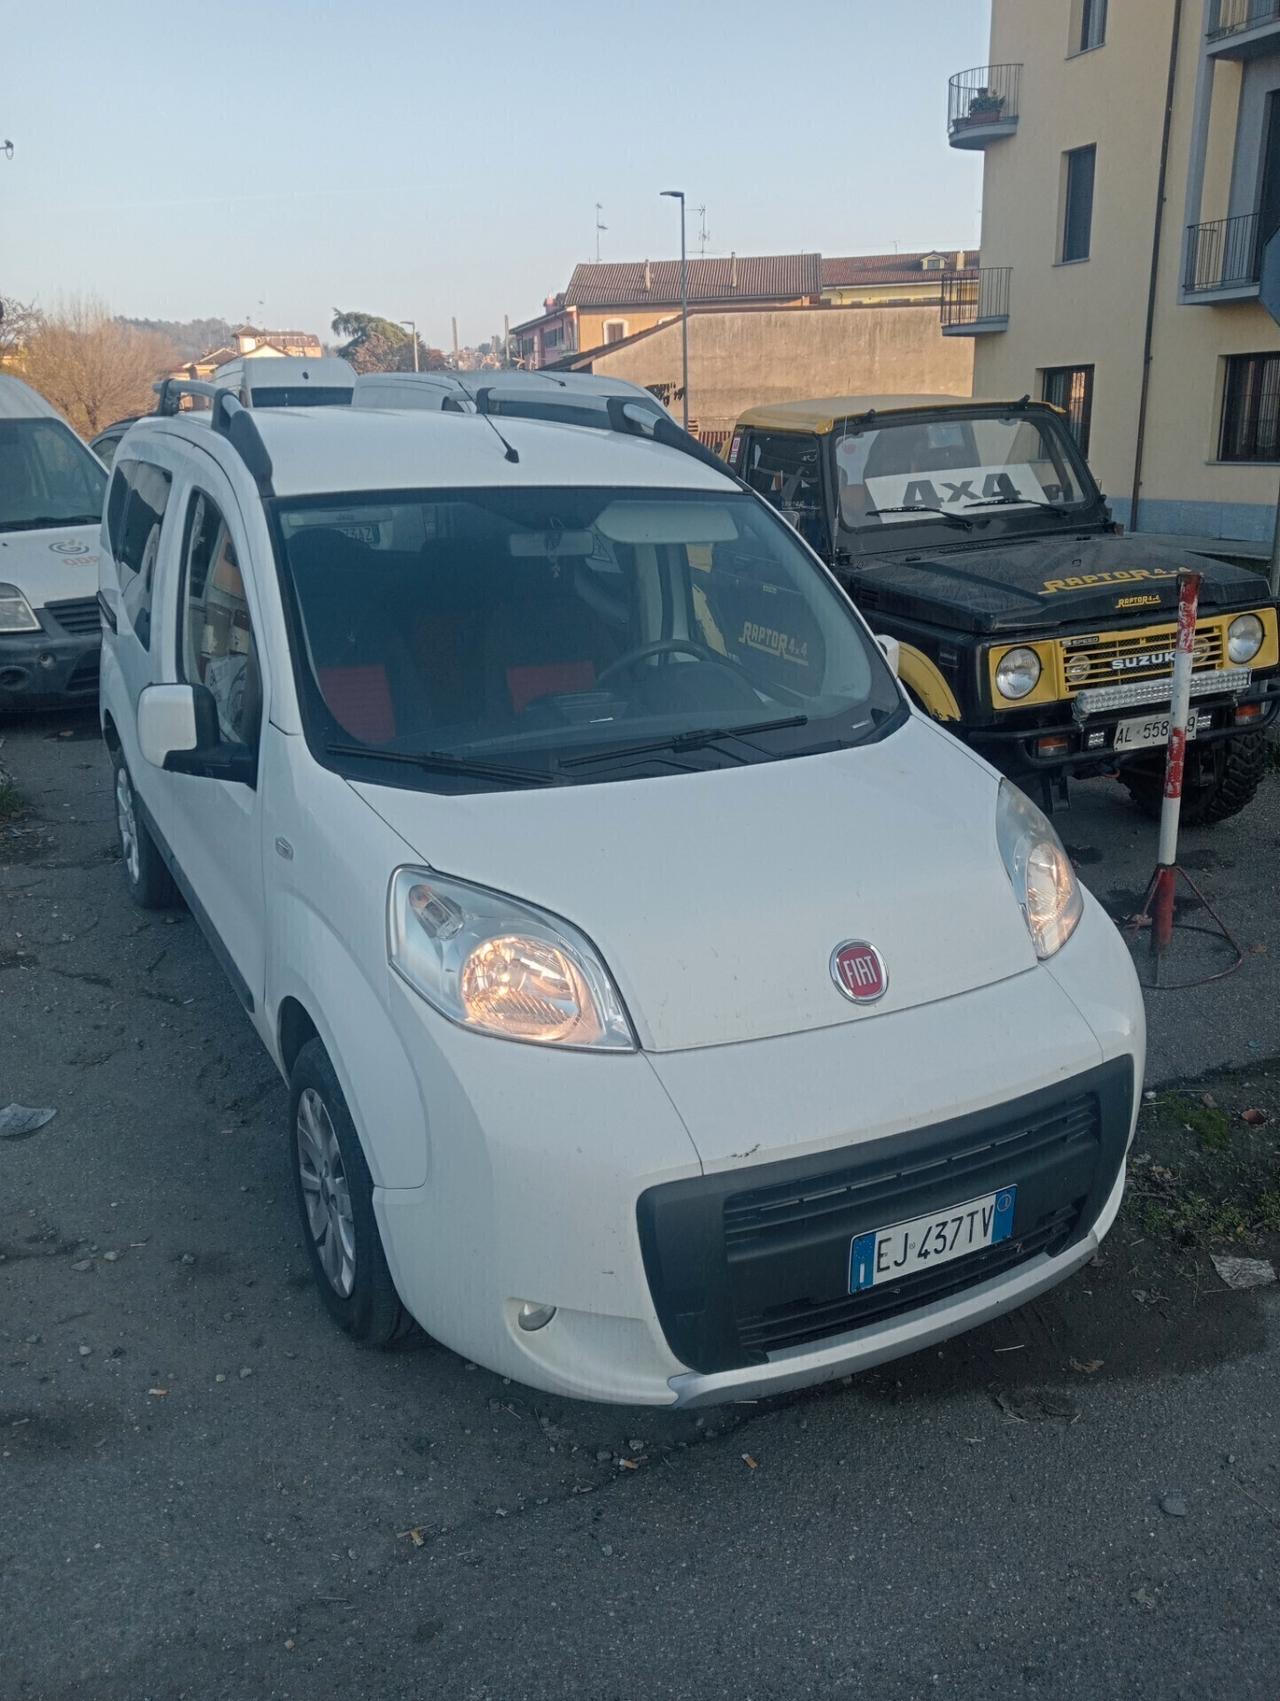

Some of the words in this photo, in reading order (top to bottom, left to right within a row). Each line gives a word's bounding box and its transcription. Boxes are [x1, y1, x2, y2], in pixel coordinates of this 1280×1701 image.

[1038, 569, 1151, 595] RAPTOR
[1115, 596, 1147, 608] RAPTOR
[738, 621, 788, 657] RAPTOR
[1111, 652, 1177, 670] SUZUK
[1143, 716, 1196, 739] 5589
[843, 955, 878, 988] FIAT
[876, 1232, 909, 1273] EJ
[917, 1204, 995, 1260] 437TV
